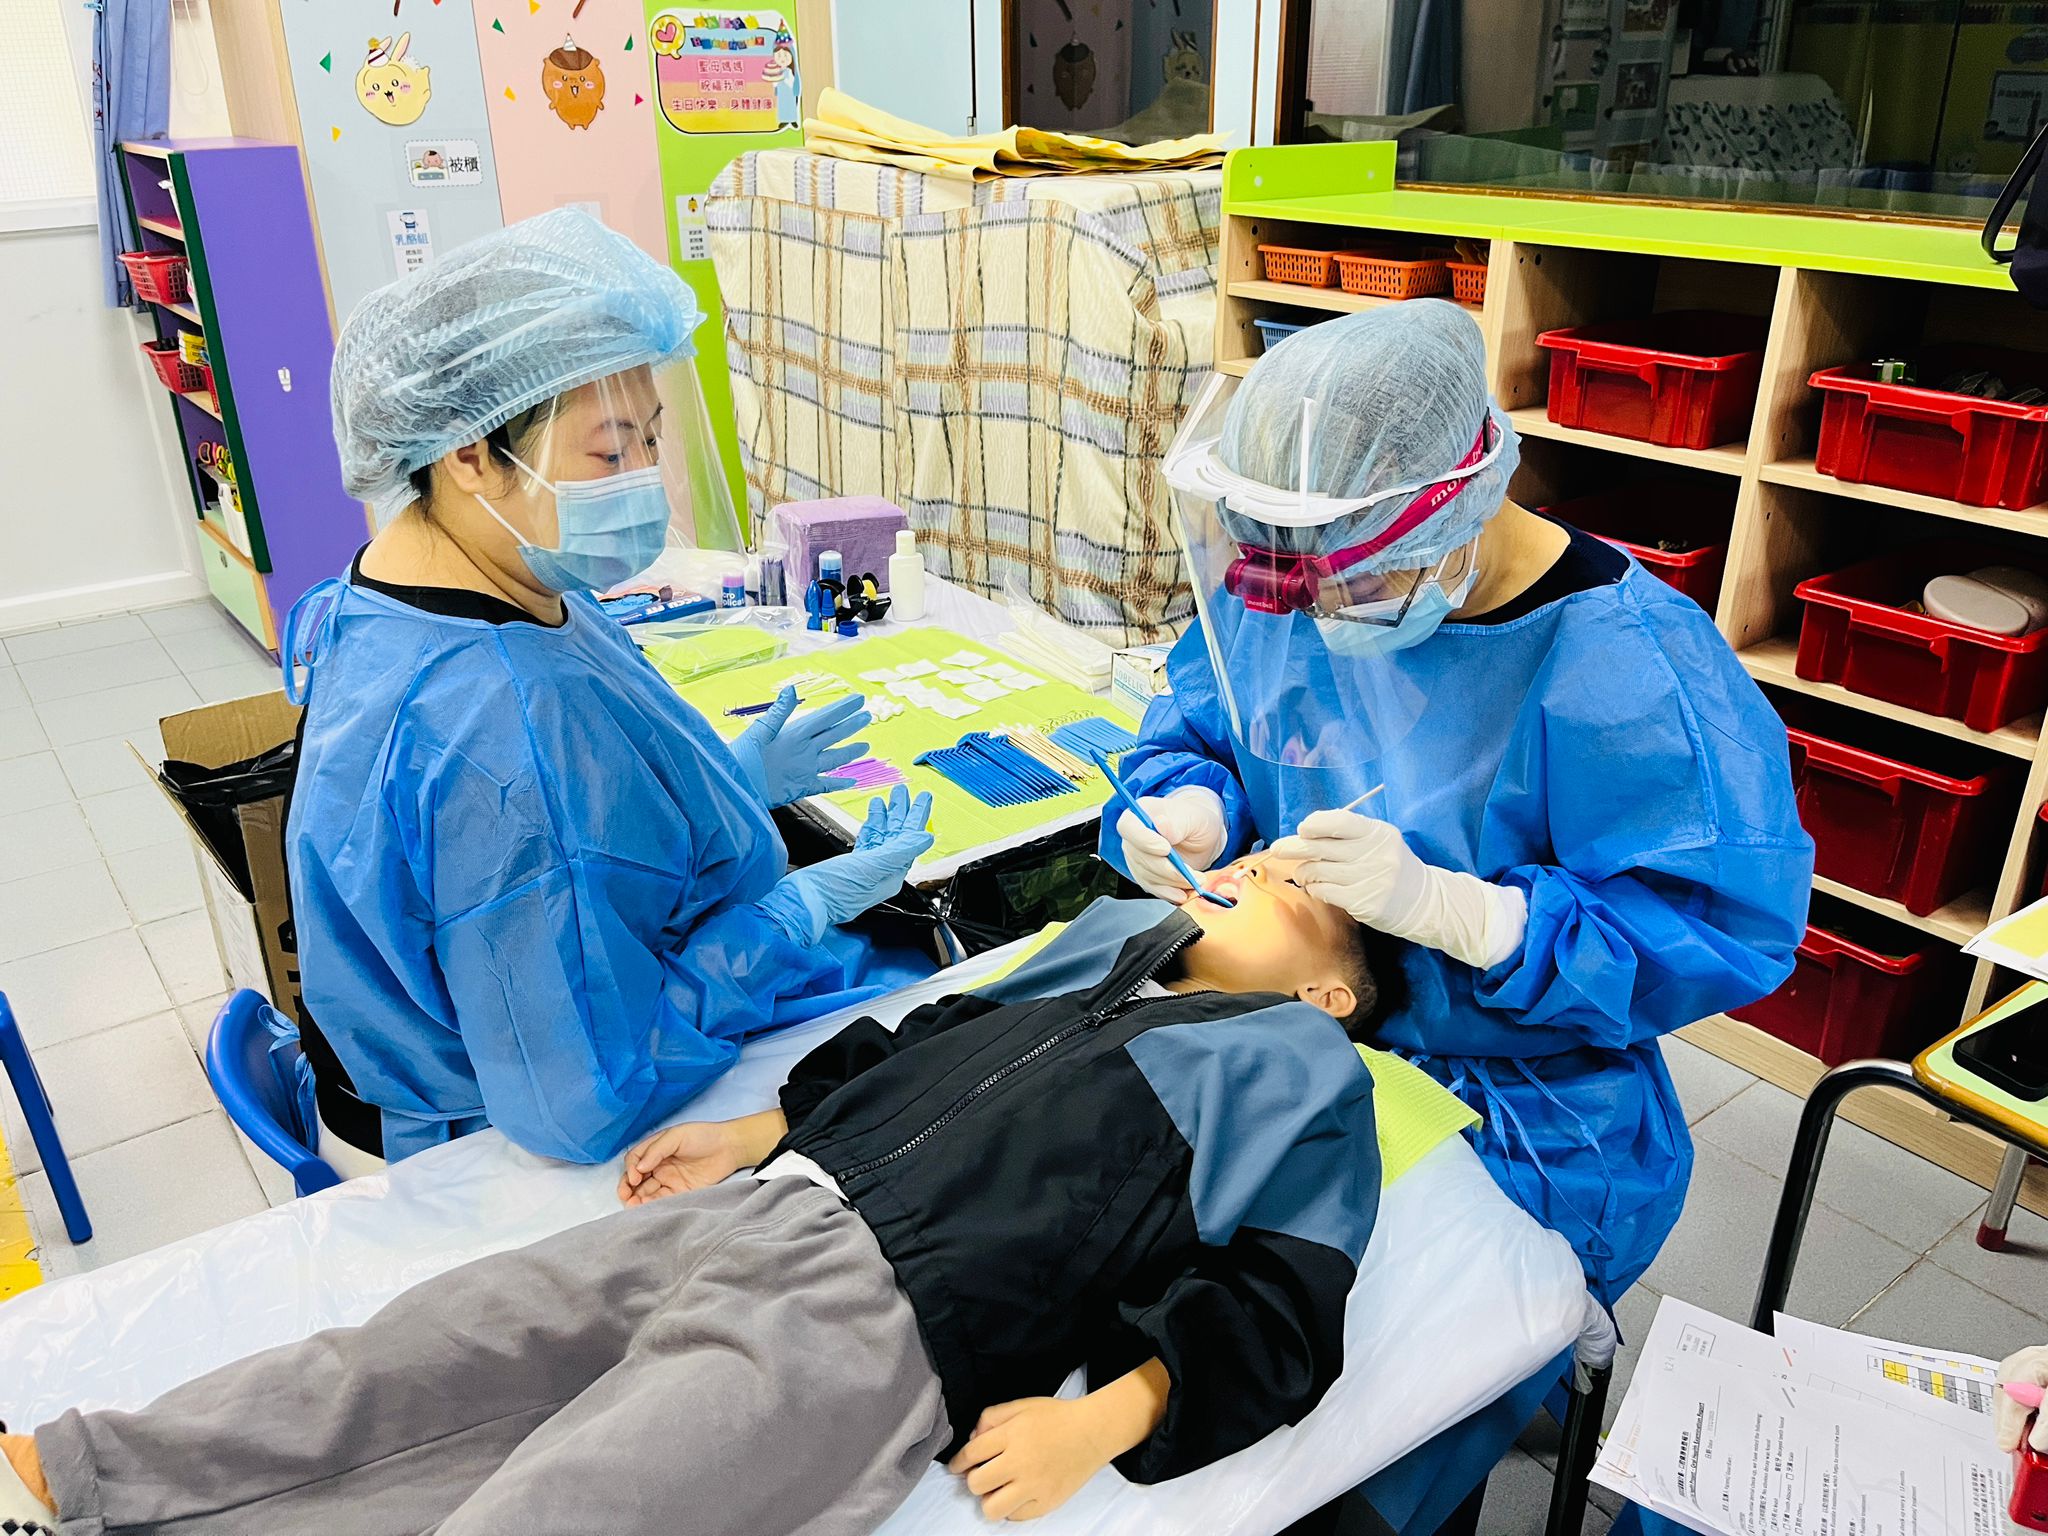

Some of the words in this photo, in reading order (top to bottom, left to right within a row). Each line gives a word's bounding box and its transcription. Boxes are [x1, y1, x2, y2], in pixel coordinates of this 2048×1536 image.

[698, 59, 744, 73] 聖母媽媽
[700, 79, 744, 92] 祝福我們
[449, 156, 480, 173] 被櫃
